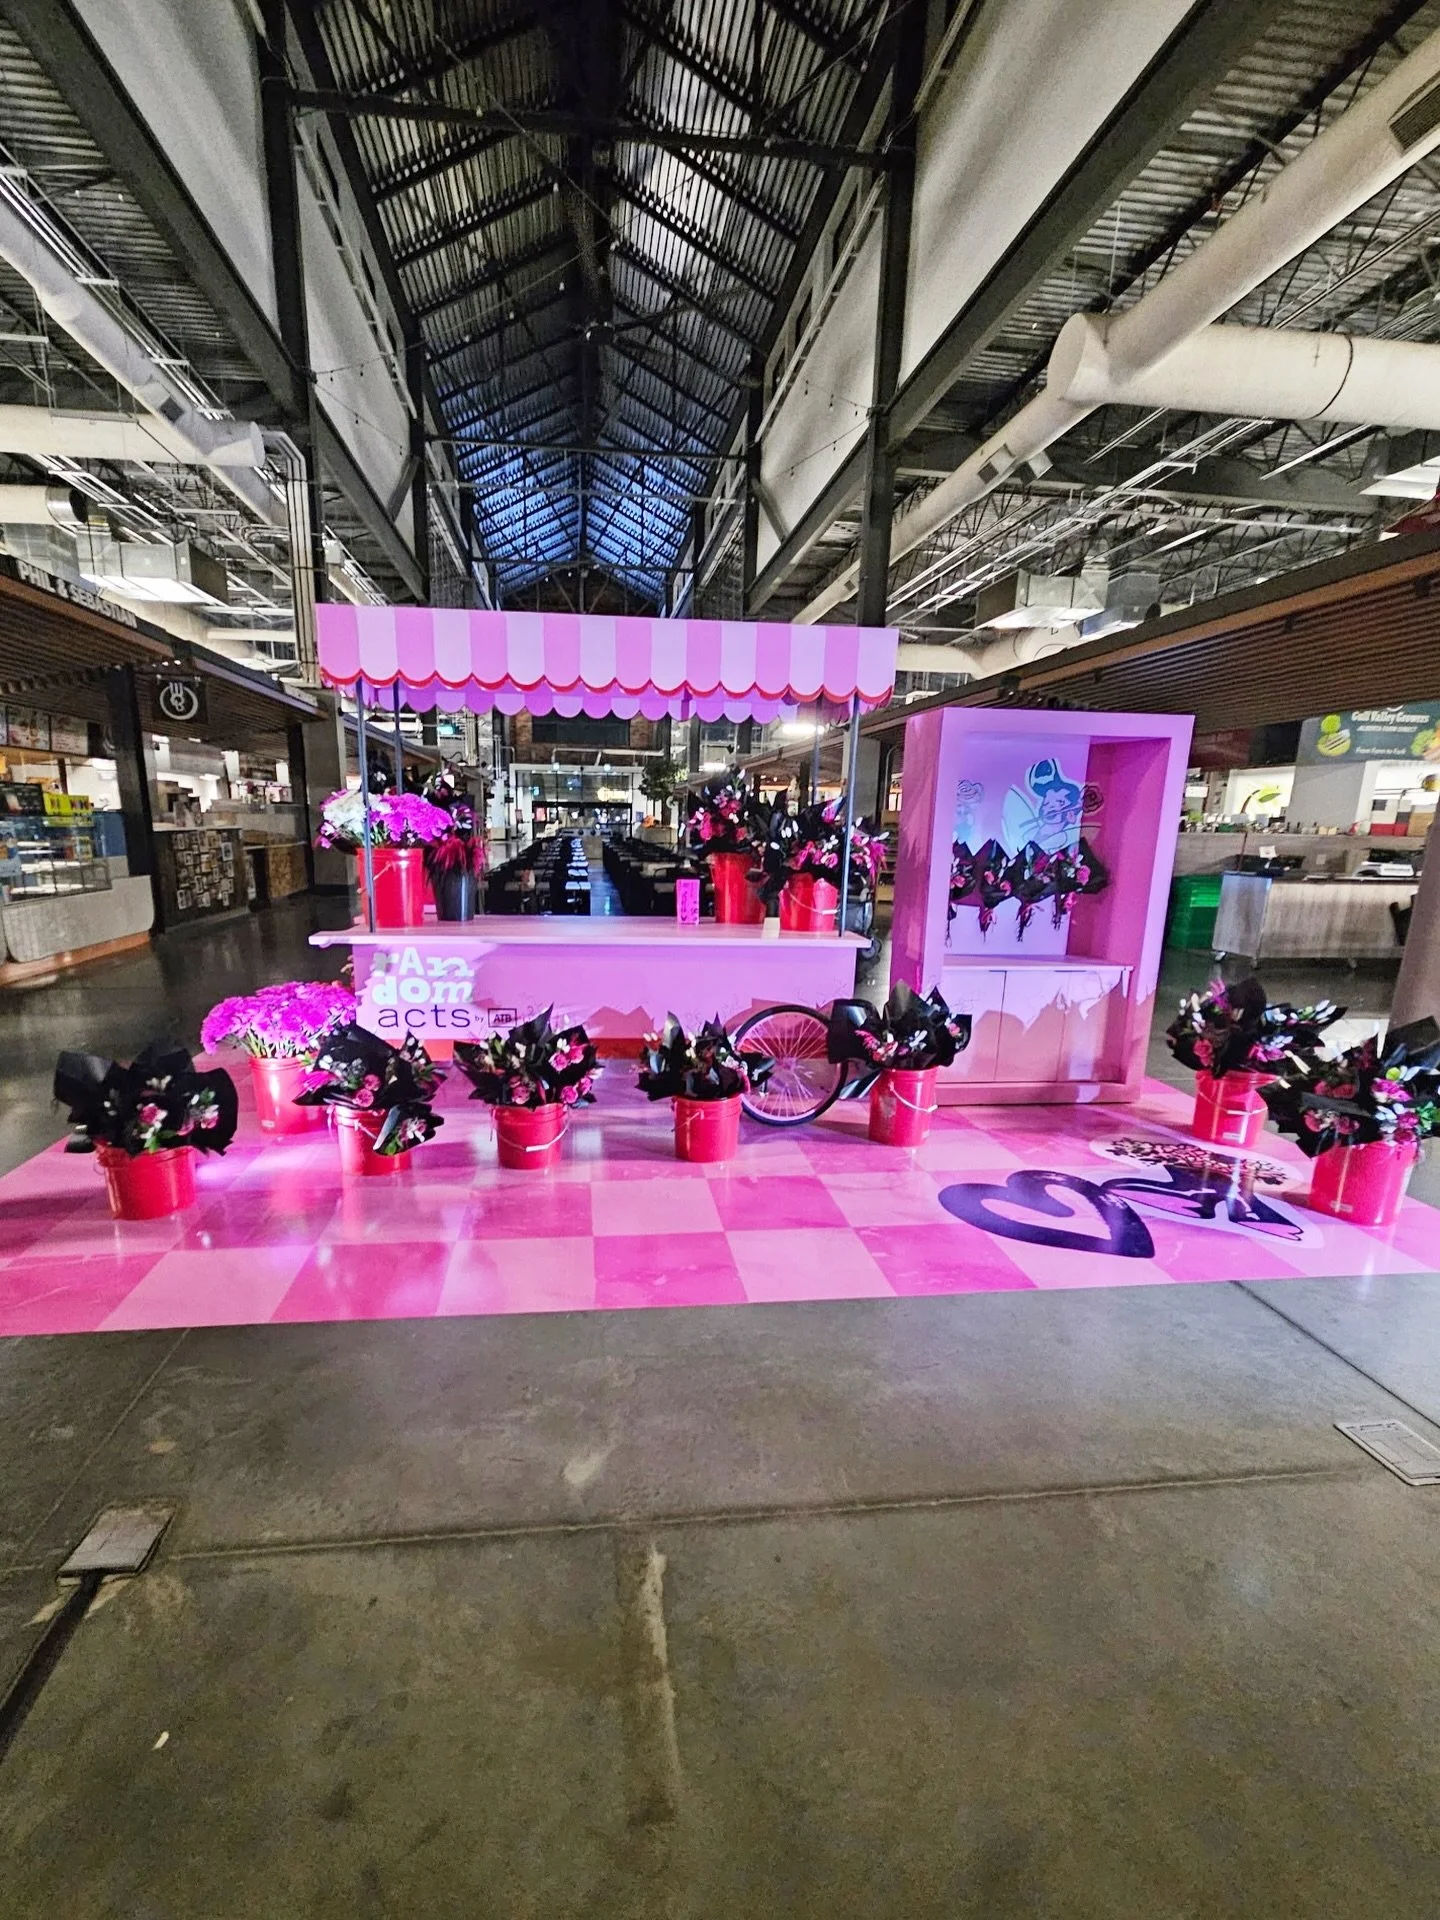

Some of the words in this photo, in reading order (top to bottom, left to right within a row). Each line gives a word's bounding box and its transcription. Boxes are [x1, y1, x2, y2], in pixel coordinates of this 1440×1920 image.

[17, 559, 56, 593] PHIL
[56, 578, 69, 599] &
[68, 583, 138, 629] SEBASTIAN
[1371, 711, 1395, 725] Valley
[377, 1004, 471, 1028] acts
[474, 1014, 485, 1023] by
[493, 1013, 512, 1024] ATB
